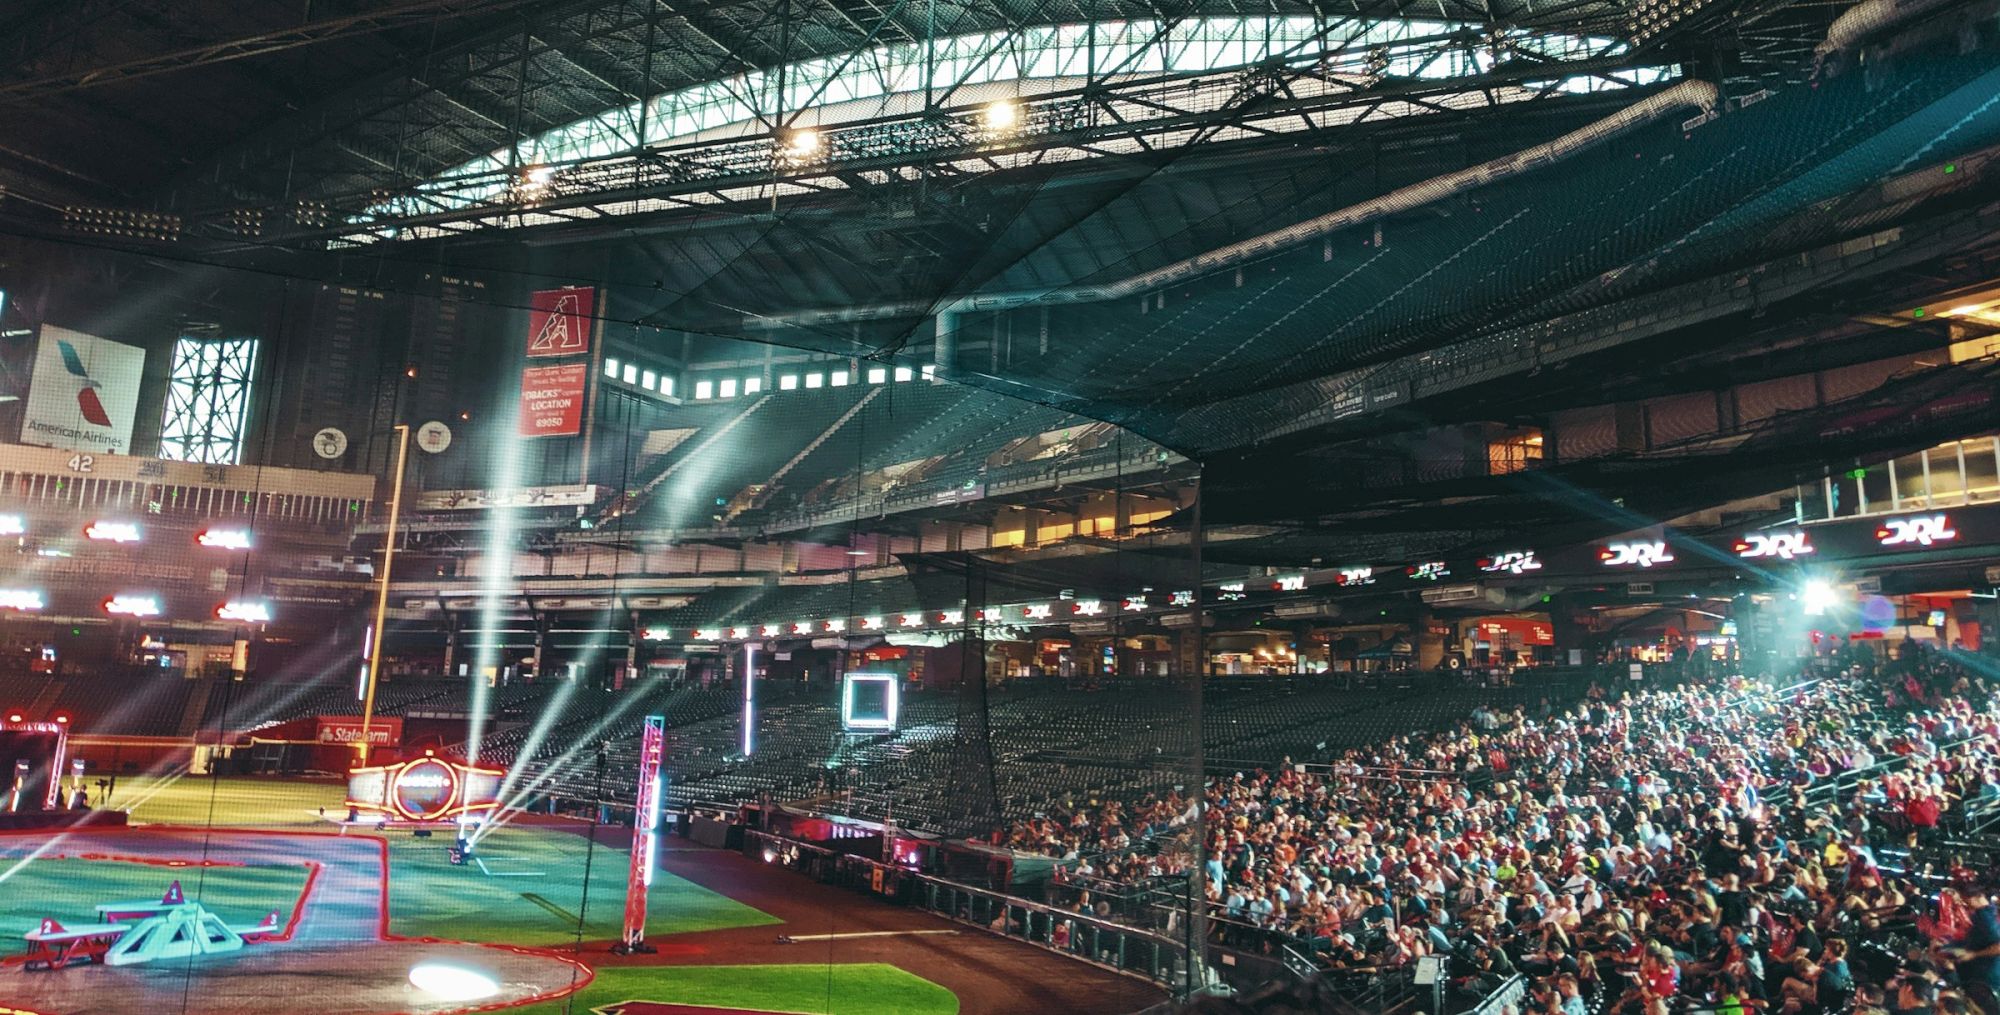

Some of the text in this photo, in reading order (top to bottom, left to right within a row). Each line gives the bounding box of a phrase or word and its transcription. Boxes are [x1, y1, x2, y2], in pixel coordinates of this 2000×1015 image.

[531, 399, 571, 411] LOCATION
[27, 420, 123, 448] American Airlines
[68, 454, 94, 473] 42
[1880, 515, 1956, 546] DRL
[1604, 542, 1674, 568] DRL
[1740, 532, 1814, 559] DRL
[170, 888, 179, 900] 1
[43, 920, 53, 933] 2
[270, 914, 277, 925] 3
